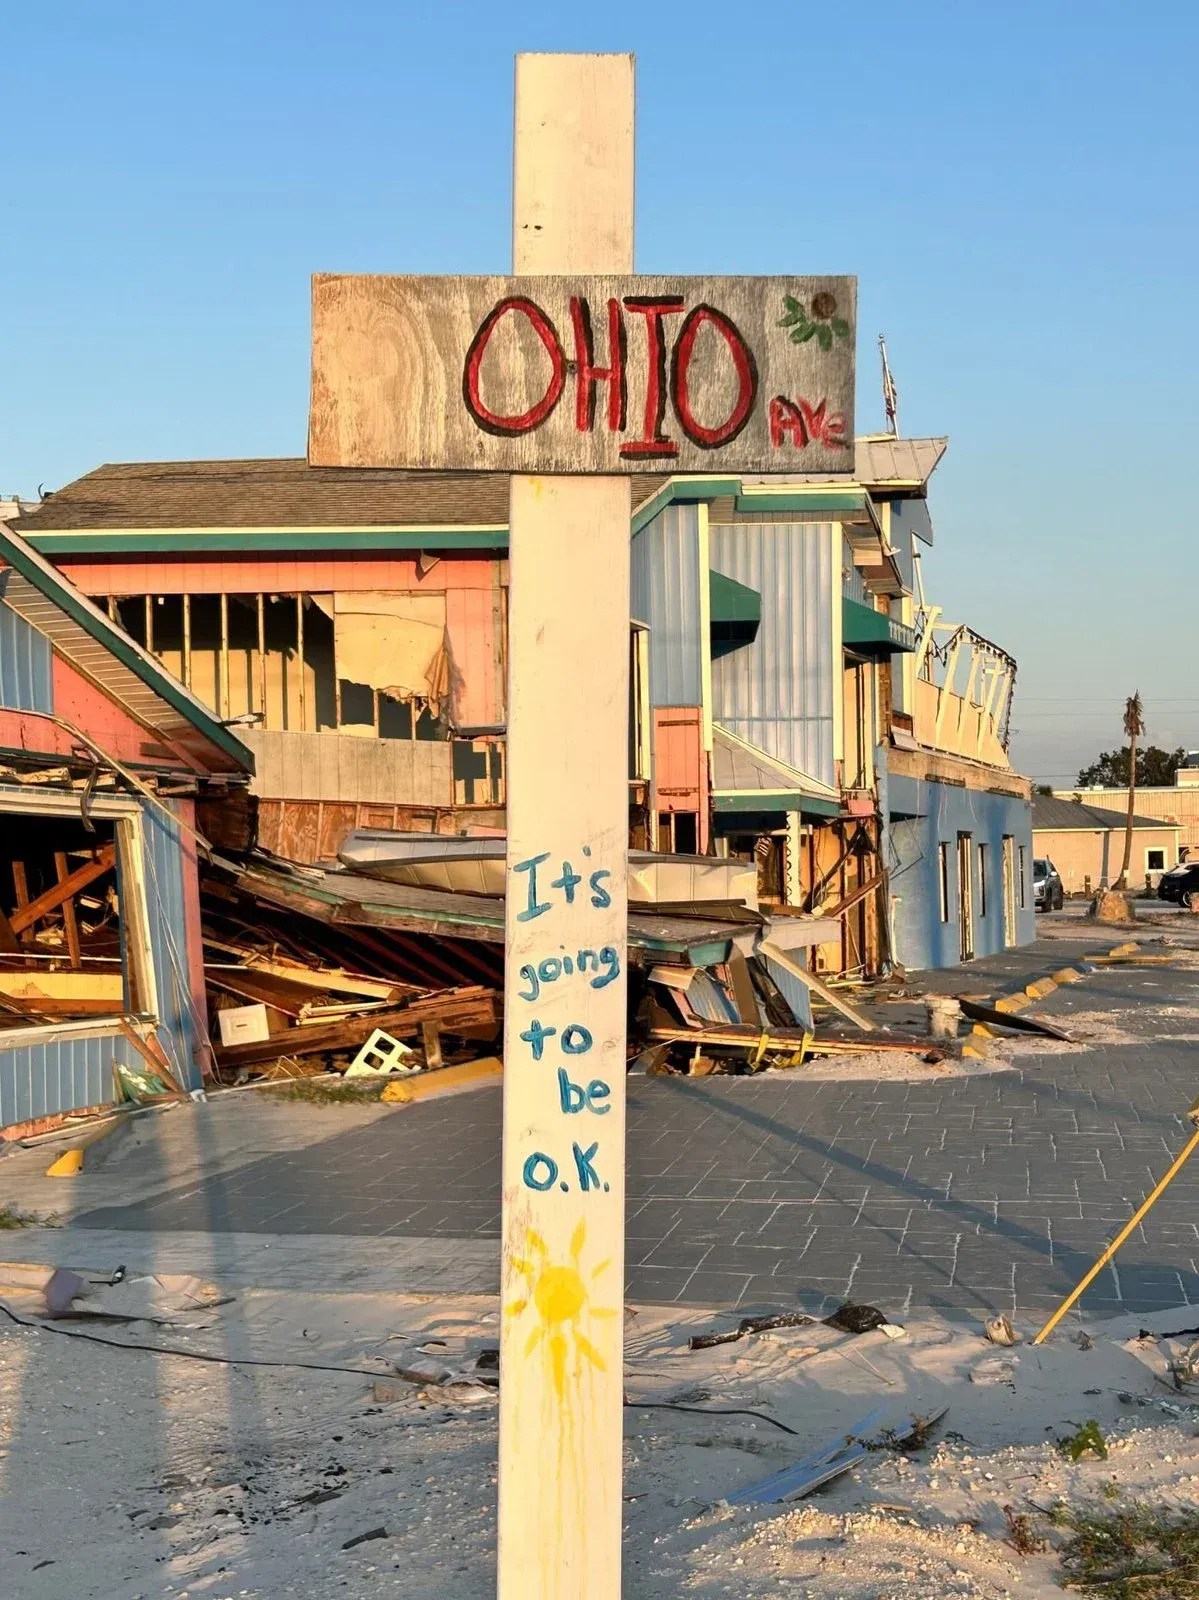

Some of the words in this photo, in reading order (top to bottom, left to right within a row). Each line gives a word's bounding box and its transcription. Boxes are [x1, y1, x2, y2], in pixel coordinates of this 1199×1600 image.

[463, 295, 759, 460] OHIO
[513, 845, 612, 922] It's
[518, 944, 621, 1001] going
[520, 1019, 593, 1061] to
[557, 1066, 611, 1115] be
[522, 1141, 610, 1192] O.K.
